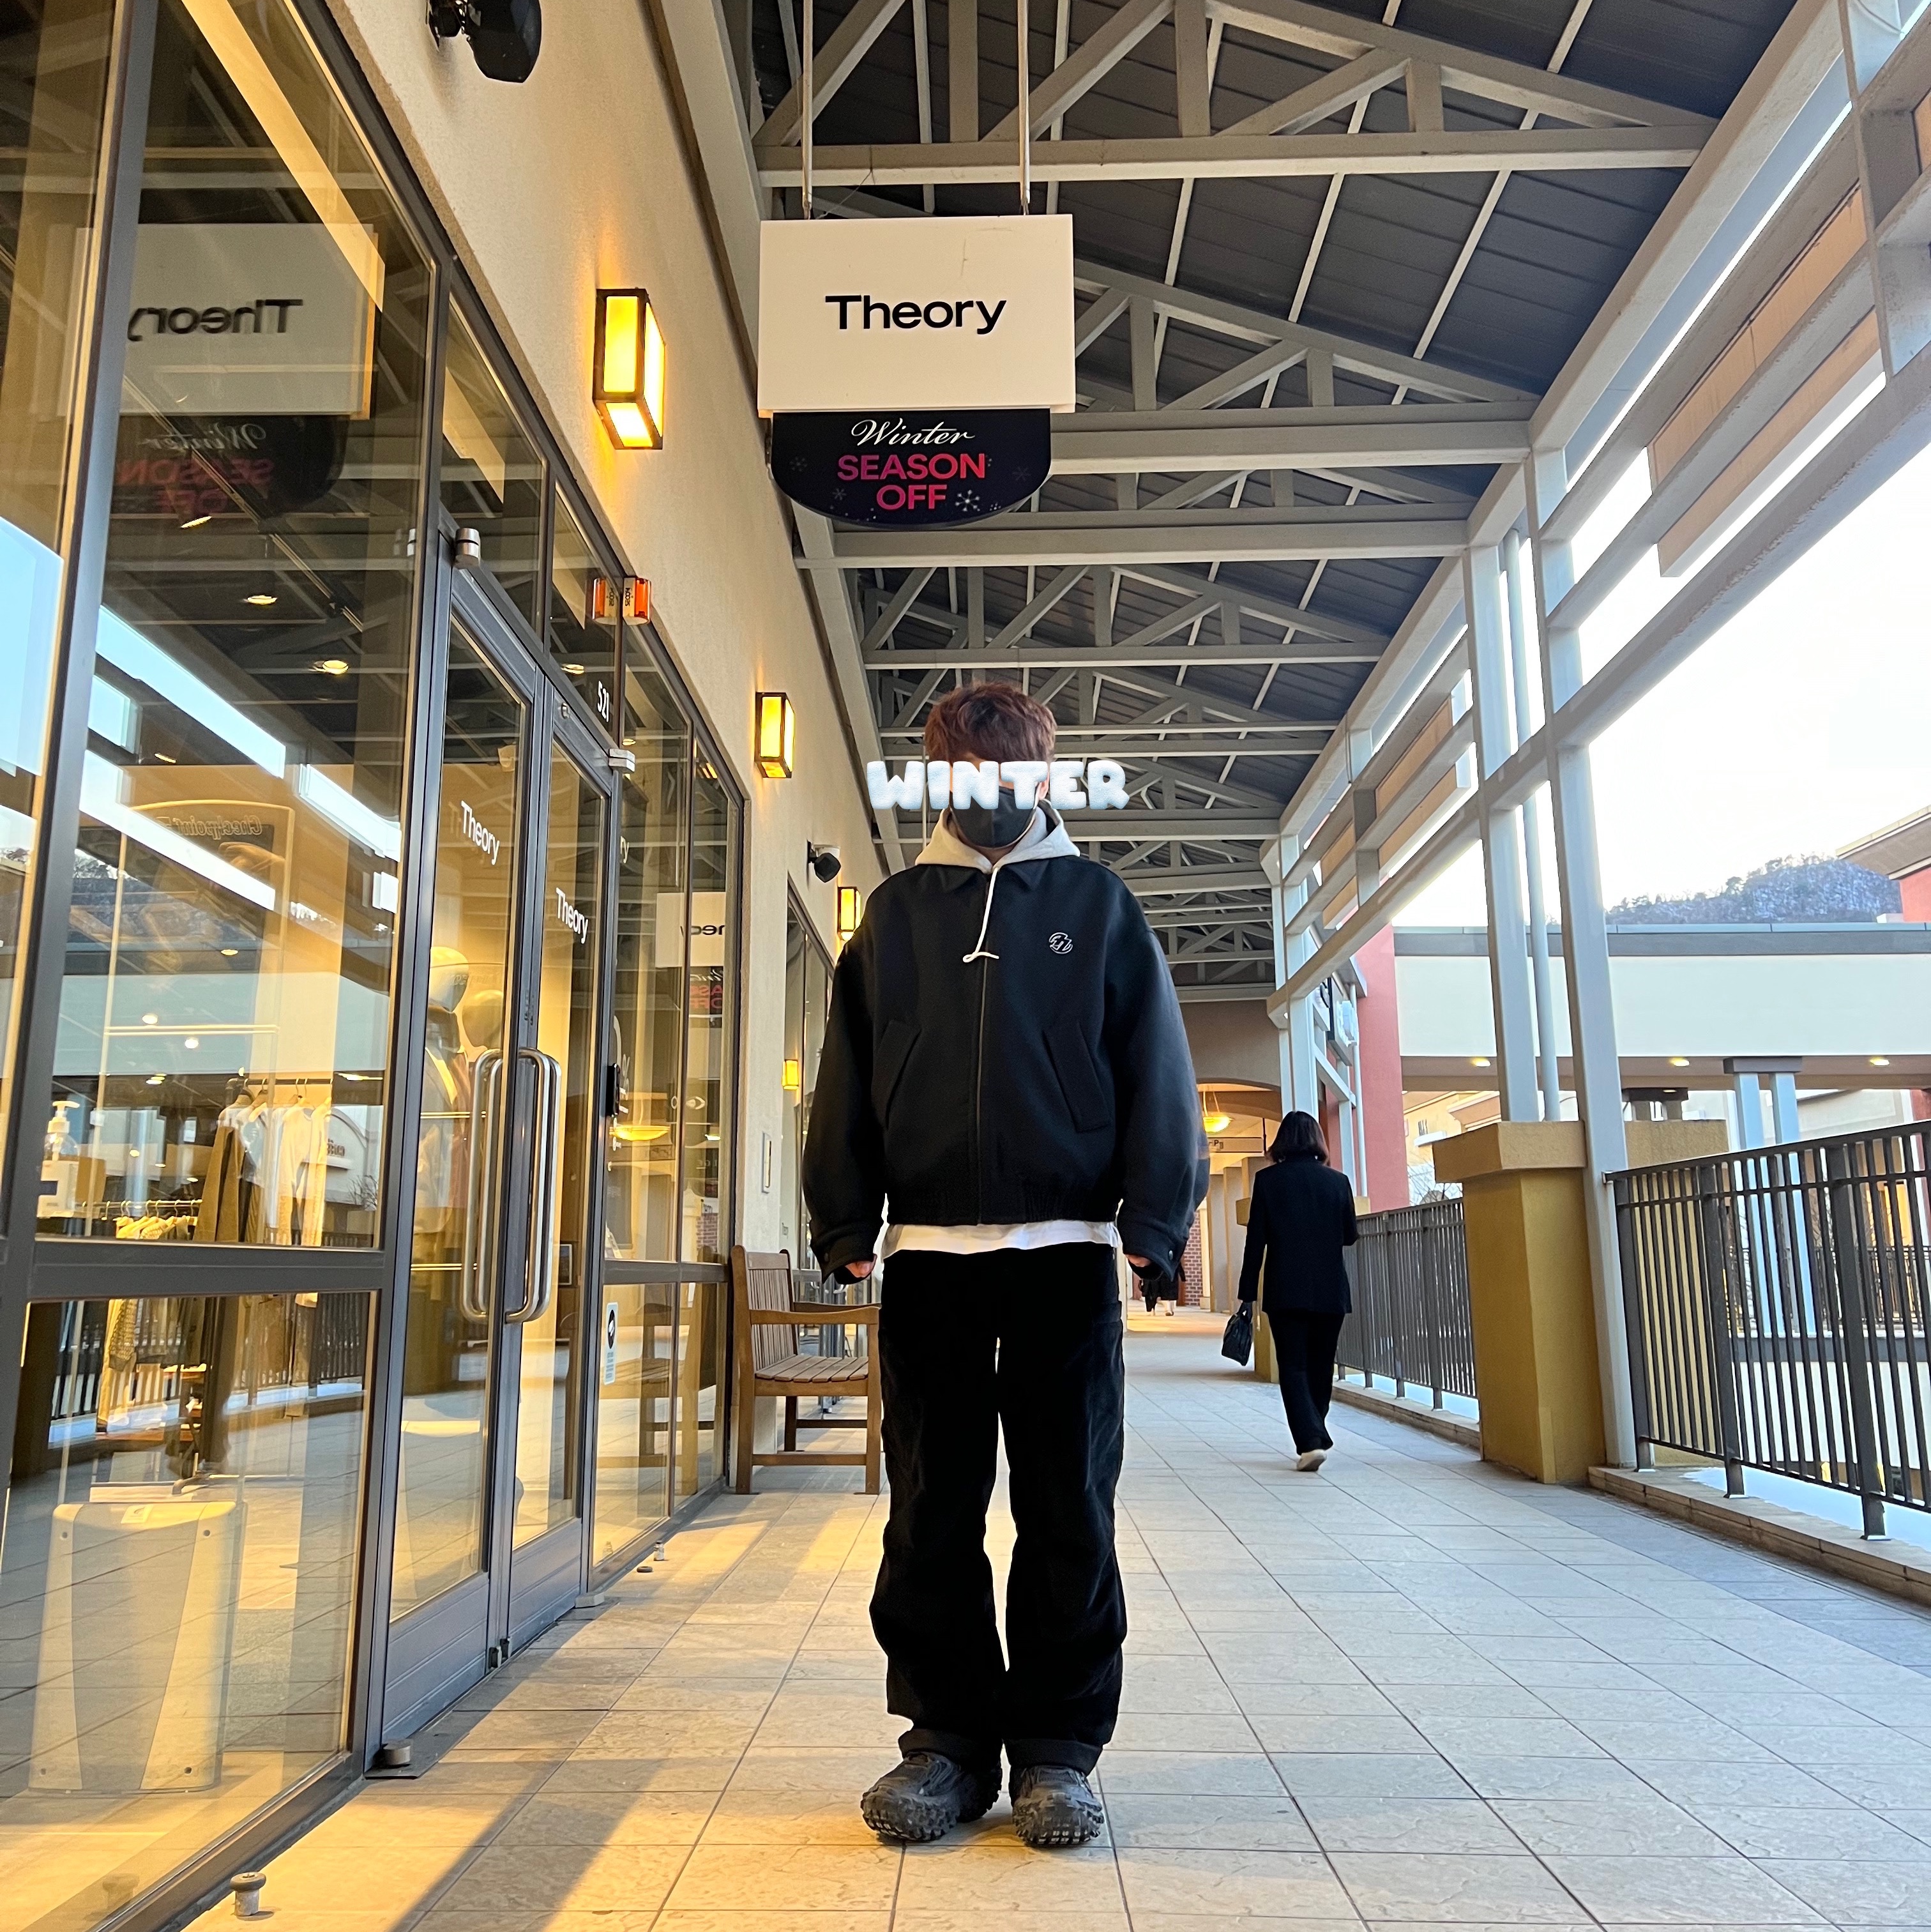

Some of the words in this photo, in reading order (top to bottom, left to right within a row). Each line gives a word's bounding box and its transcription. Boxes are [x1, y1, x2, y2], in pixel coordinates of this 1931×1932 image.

[825, 294, 1007, 335] Theory
[851, 417, 976, 446] Winter
[837, 453, 985, 481] SEASON
[876, 483, 948, 510] OFF
[597, 680, 609, 723] 521
[460, 800, 501, 865] Theory
[556, 888, 589, 944] Theory
